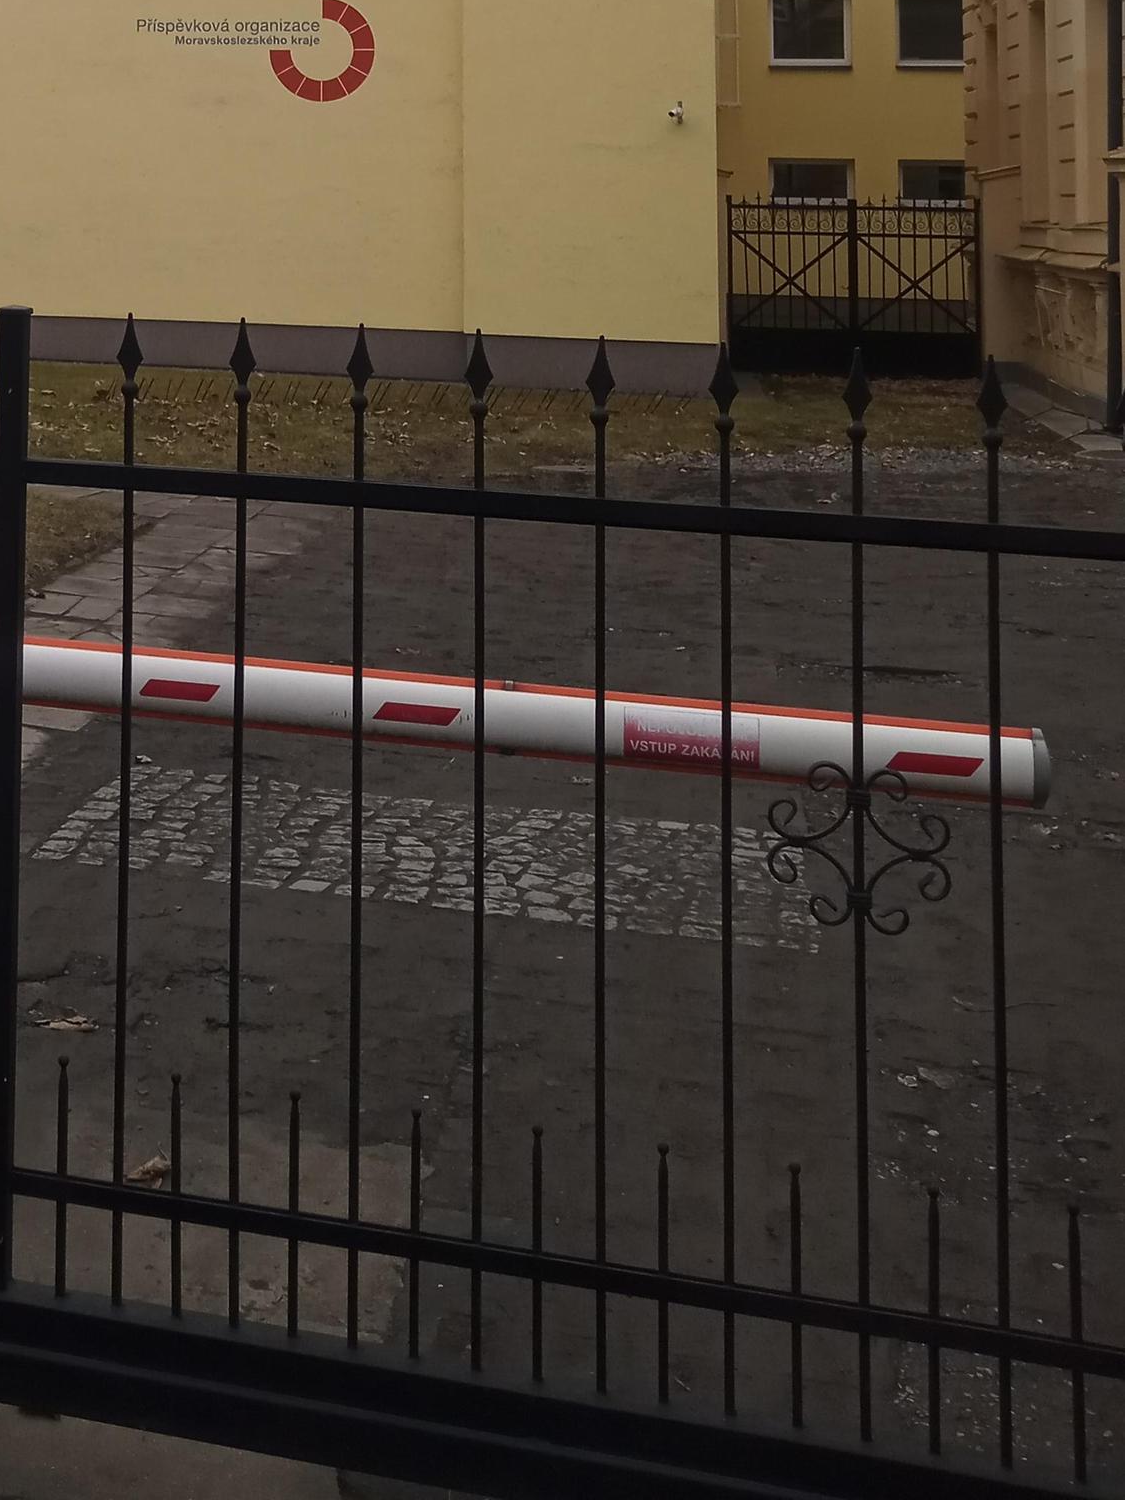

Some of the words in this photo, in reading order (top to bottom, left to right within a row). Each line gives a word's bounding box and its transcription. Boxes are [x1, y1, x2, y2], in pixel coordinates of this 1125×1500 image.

[136, 18, 230, 35] Příspěvková
[234, 18, 321, 36] organizace
[175, 35, 288, 46] Moravskoslezského
[290, 35, 321, 46] kraje
[630, 739, 677, 755] VSTUP
[681, 743, 755, 762] ZAKÁÁN!
